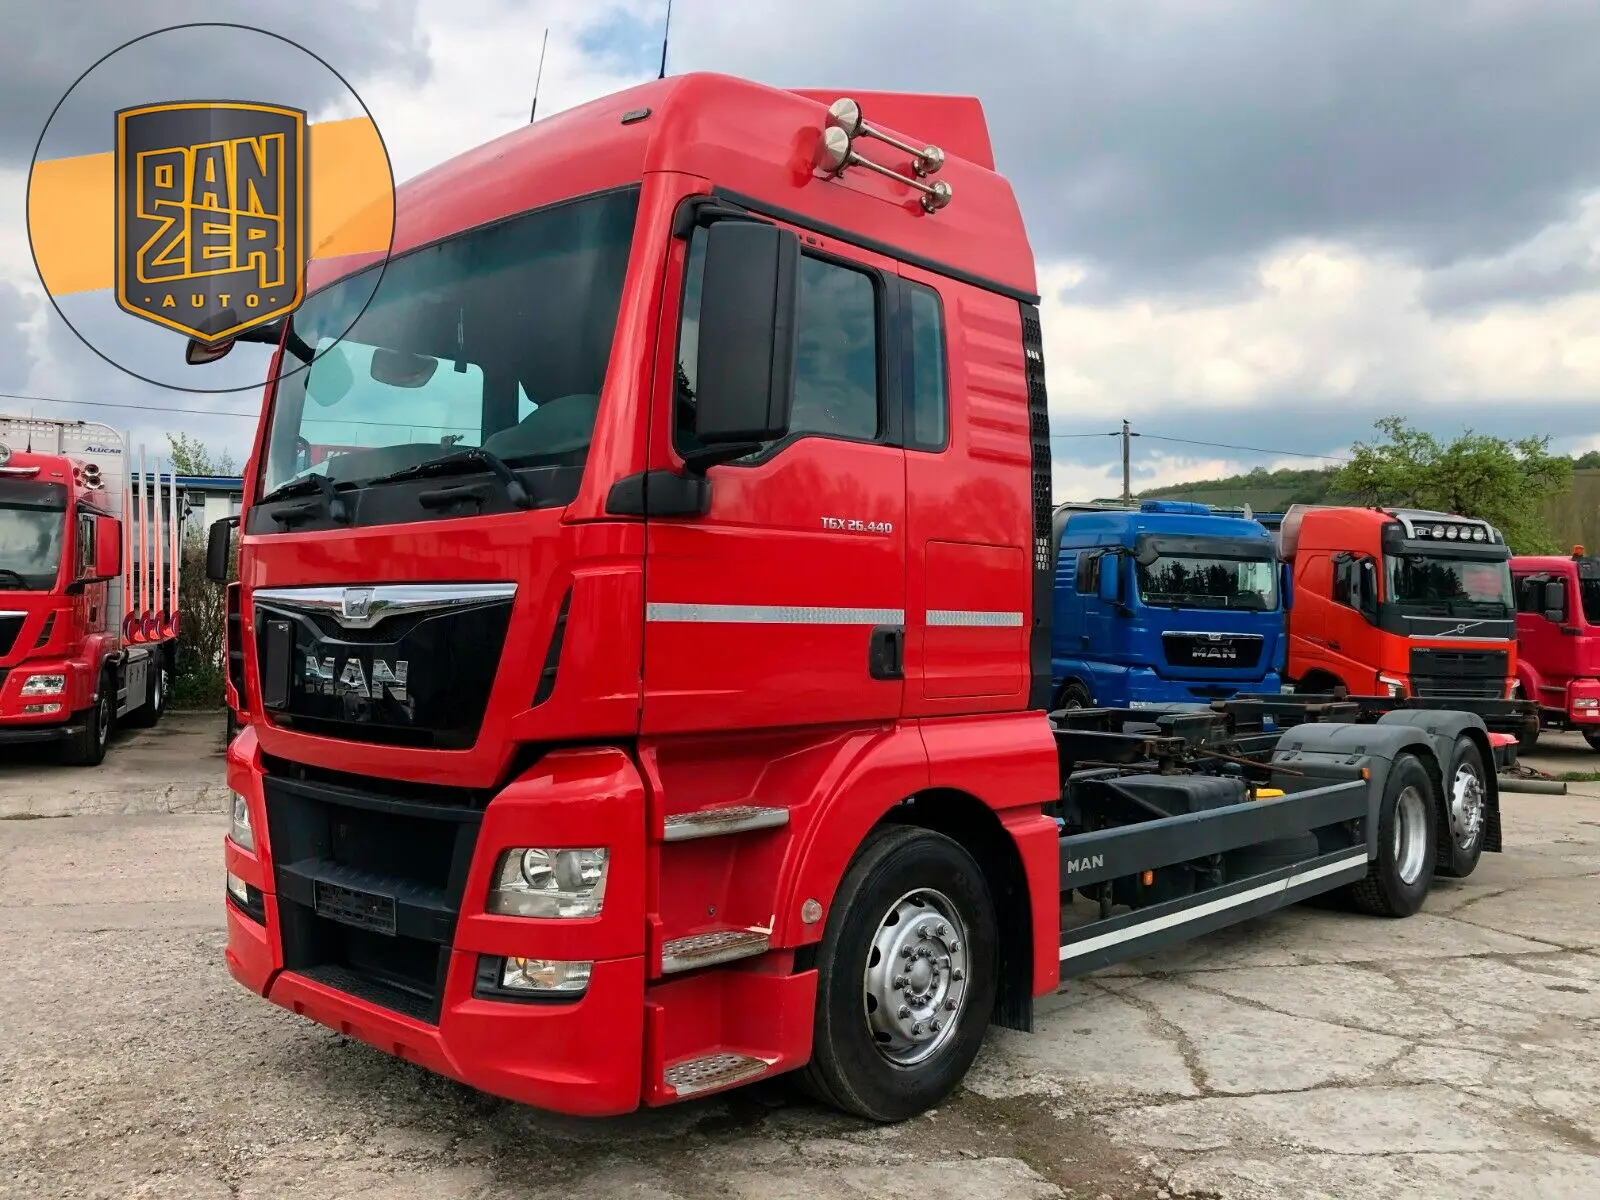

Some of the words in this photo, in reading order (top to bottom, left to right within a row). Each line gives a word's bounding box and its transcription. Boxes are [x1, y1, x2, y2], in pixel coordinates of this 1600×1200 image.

[821, 517, 845, 530] TGX
[847, 520, 893, 533] 26.440
[1192, 647, 1236, 659] MAN
[305, 655, 409, 700] MAN
[1067, 854, 1104, 874] MAN
